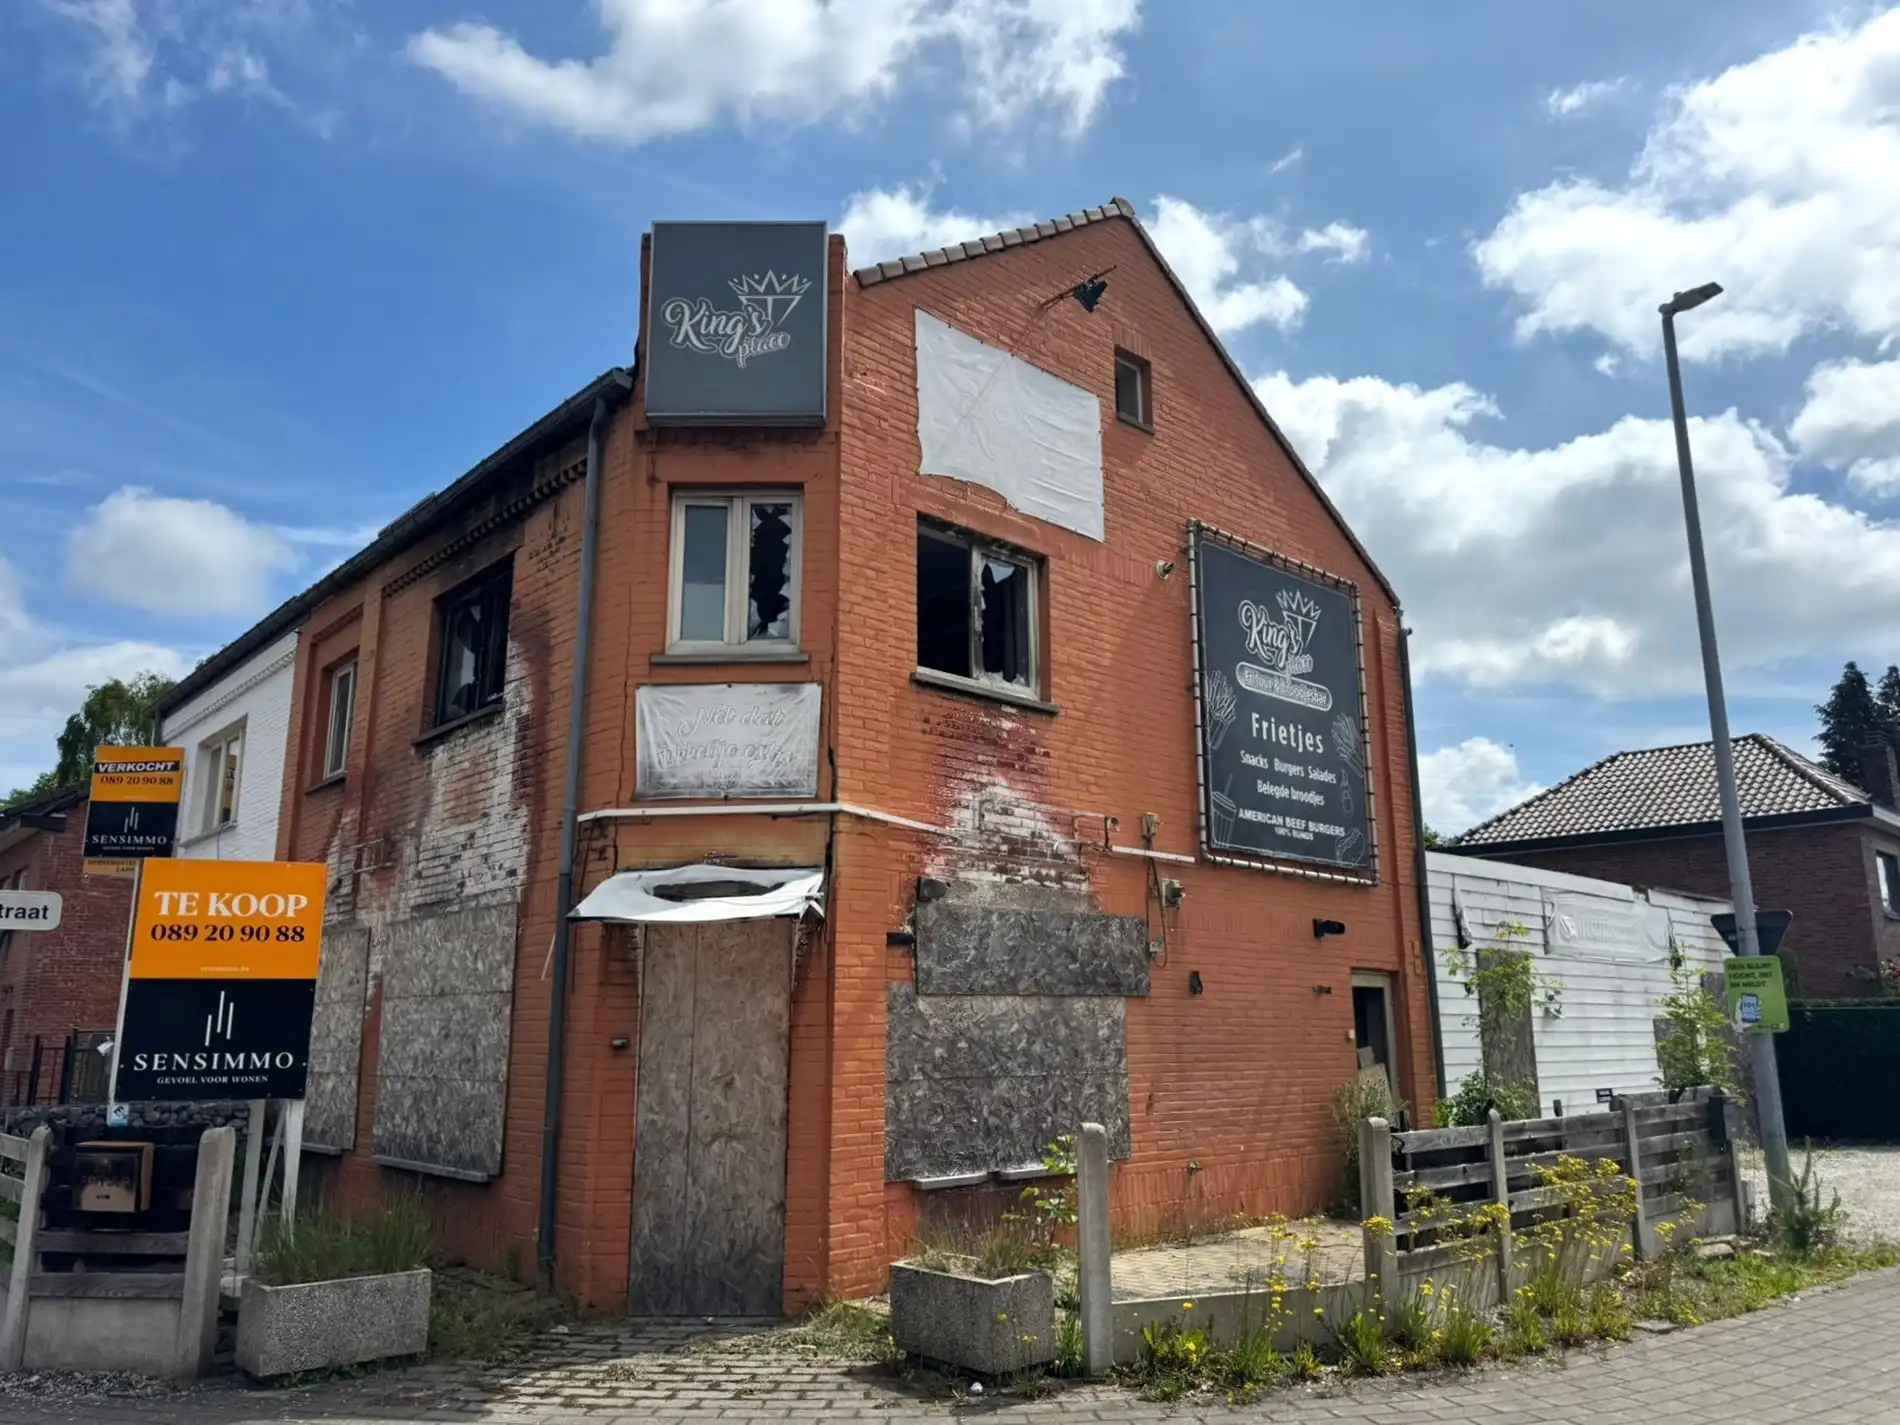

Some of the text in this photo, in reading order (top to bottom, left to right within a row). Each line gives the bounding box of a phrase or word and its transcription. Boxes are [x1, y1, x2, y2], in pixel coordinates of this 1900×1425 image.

[664, 299, 768, 355] King's
[1240, 603, 1301, 669] King's
[1251, 712, 1324, 753] Frietjes
[98, 761, 175, 773] VERKOCHT
[100, 775, 174, 785] 089 20 90 88
[1240, 750, 1337, 784] Snacks Burgers Salades
[1257, 779, 1325, 807] Belegde broodjes
[1238, 808, 1346, 837] AMERICAN BEEF BURGERS
[91, 834, 168, 845] SENSIMMO
[154, 891, 309, 918] TE KOOP
[151, 923, 305, 943] 089 20 90 88
[133, 1051, 294, 1072] SENSIMMO
[156, 1075, 269, 1084] GEVOEL VOOR WONEN
